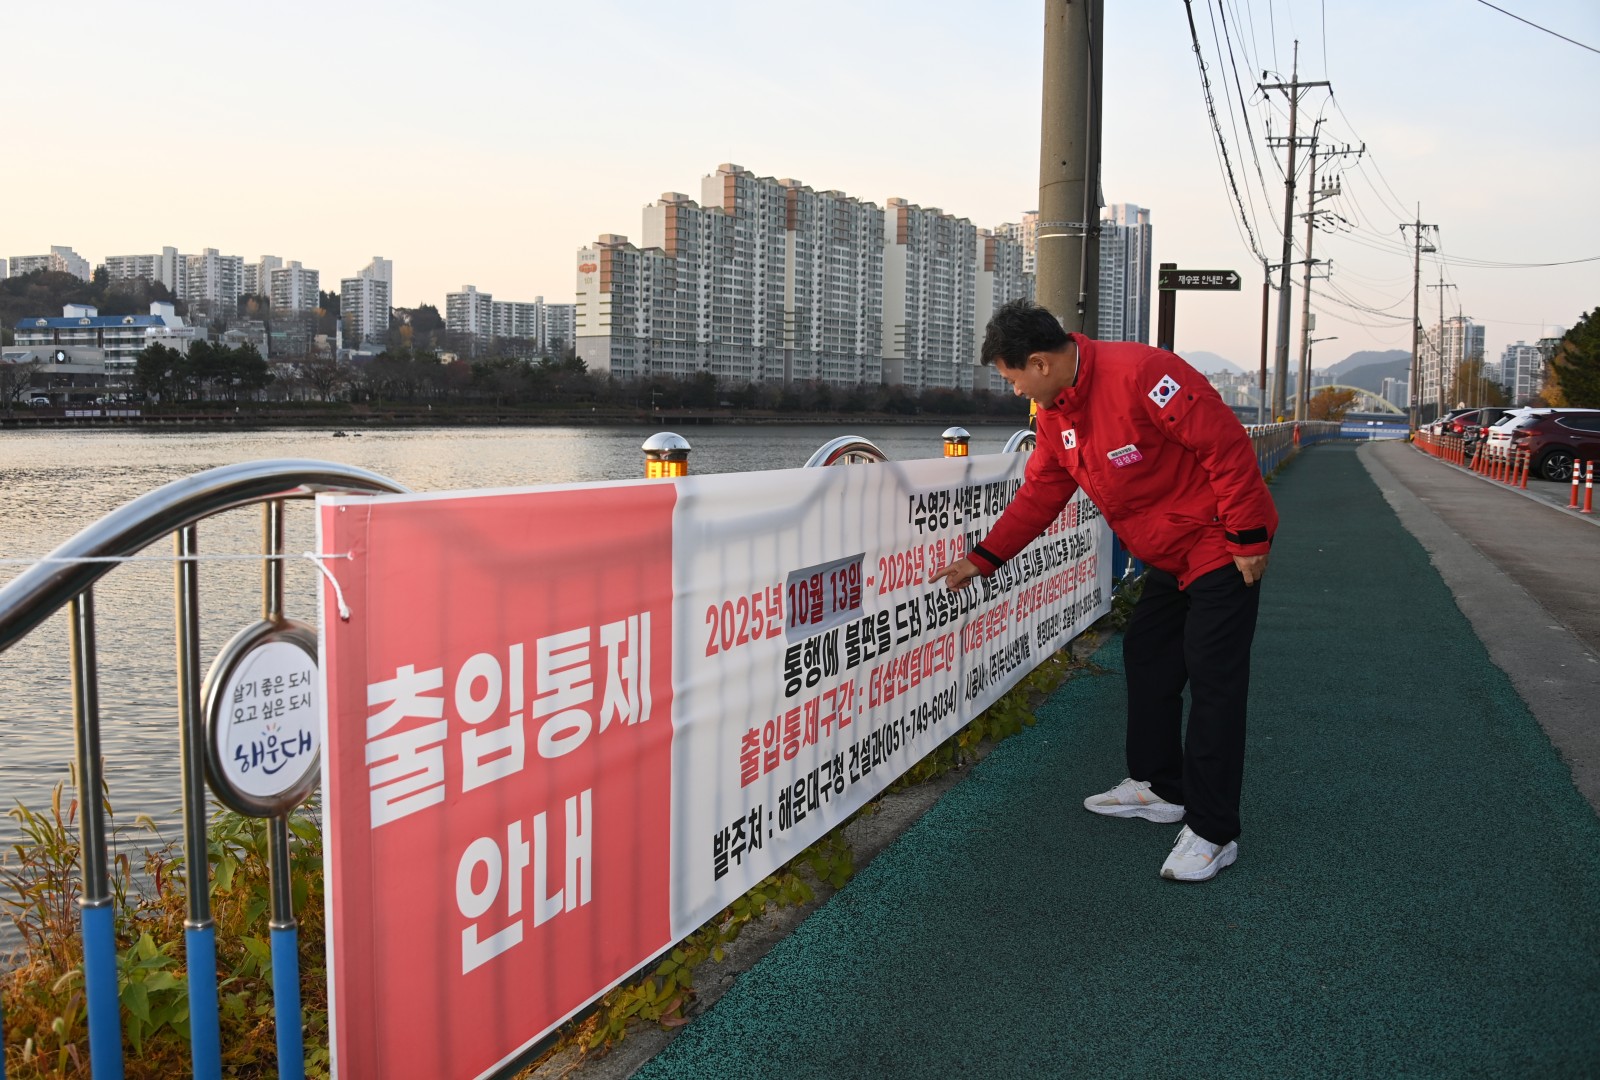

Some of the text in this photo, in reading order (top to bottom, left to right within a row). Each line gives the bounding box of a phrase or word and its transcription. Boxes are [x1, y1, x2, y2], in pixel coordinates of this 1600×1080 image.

[1201, 275, 1224, 285] 안내판
[1114, 453, 1138, 466] 김성수
[954, 484, 981, 526] 산책로
[705, 582, 783, 657] 2025년
[788, 572, 824, 628] 10월
[831, 561, 861, 612] 13일
[878, 544, 924, 595] 2026년
[928, 538, 946, 578] 3월
[784, 628, 839, 698] 통행에
[845, 609, 891, 670] 불편을
[896, 597, 922, 645] 드려
[234, 670, 311, 703] 살기 좋은 도시
[234, 691, 312, 725] 오고 싶은 도시
[365, 611, 651, 829] 출입통제
[740, 679, 855, 789] 출입통제구간
[960, 613, 985, 657] 102동
[234, 728, 312, 775] 해운대
[714, 804, 763, 882] 발주처
[779, 751, 845, 832] 해운대구청
[849, 680, 958, 784] 건설과(051-749-6034)
[456, 788, 592, 975] 안내
